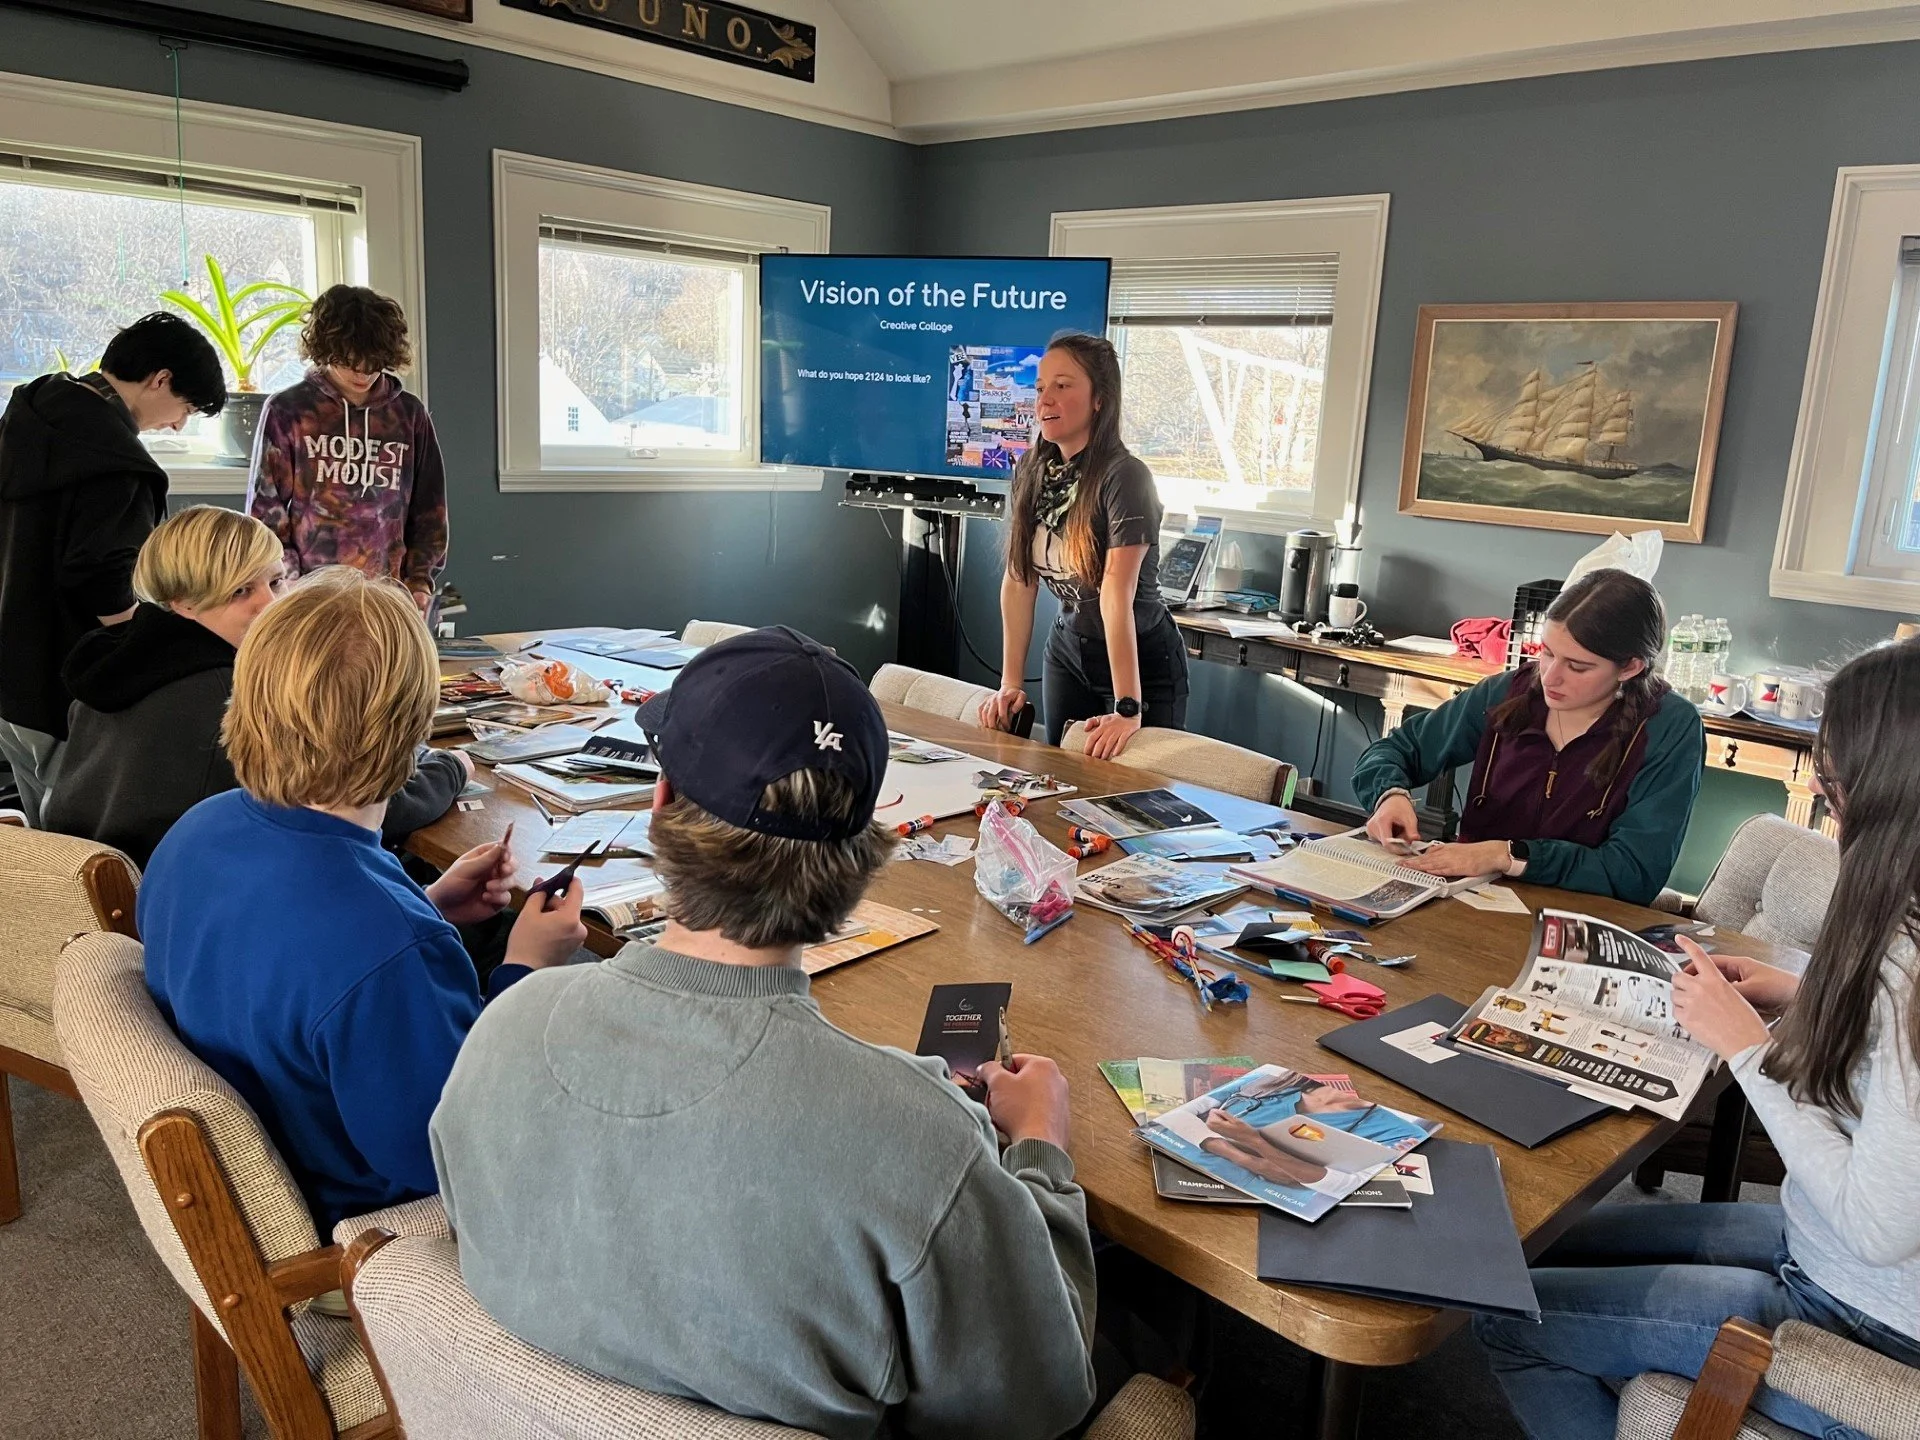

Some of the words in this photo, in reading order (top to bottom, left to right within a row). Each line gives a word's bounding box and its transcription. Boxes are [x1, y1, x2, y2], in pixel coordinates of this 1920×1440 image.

[800, 279, 880, 305] Vision
[888, 281, 916, 307] of
[922, 282, 966, 308] the
[972, 282, 1067, 310] Future
[880, 320, 917, 331] Creative
[919, 321, 953, 333] Collage
[797, 369, 818, 379] What
[818, 370, 828, 379] do
[829, 371, 844, 381] you
[845, 371, 864, 382] hope
[865, 372, 884, 381] 2124
[886, 373, 894, 382] to
[895, 374, 911, 383] look
[912, 374, 931, 384] like?
[981, 389, 1011, 397] SPARKING
[303, 434, 410, 466] MODEST
[315, 459, 402, 491] MOUSE
[945, 1013, 982, 1022] TOGETHER
[1147, 1127, 1187, 1150] TRAMPOLINE
[1177, 1180, 1225, 1190] TRAMPOLINE
[1263, 1187, 1307, 1208] HEALTHCARE
